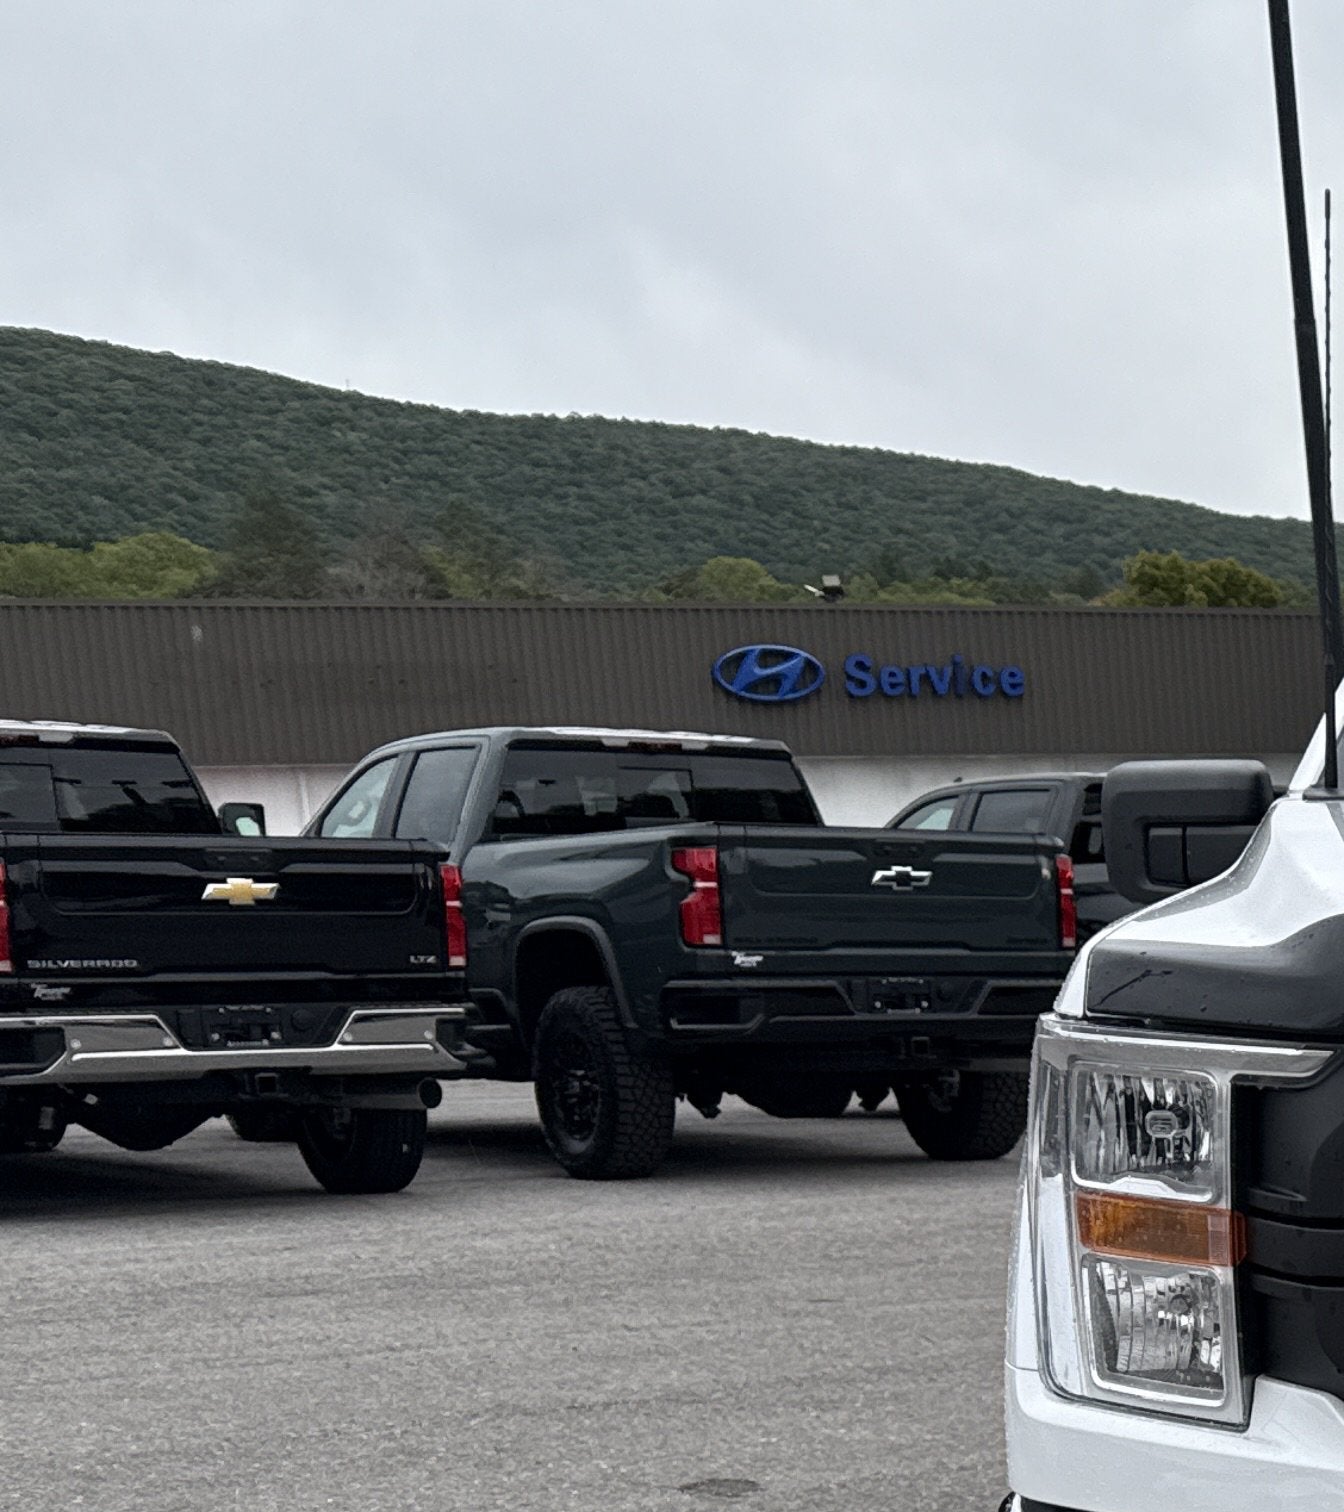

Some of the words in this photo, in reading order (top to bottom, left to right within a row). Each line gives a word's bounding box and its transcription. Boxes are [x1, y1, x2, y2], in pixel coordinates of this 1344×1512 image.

[844, 653, 1026, 698] Service
[27, 959, 138, 969] SILVERADO
[409, 955, 437, 964] LTZ
